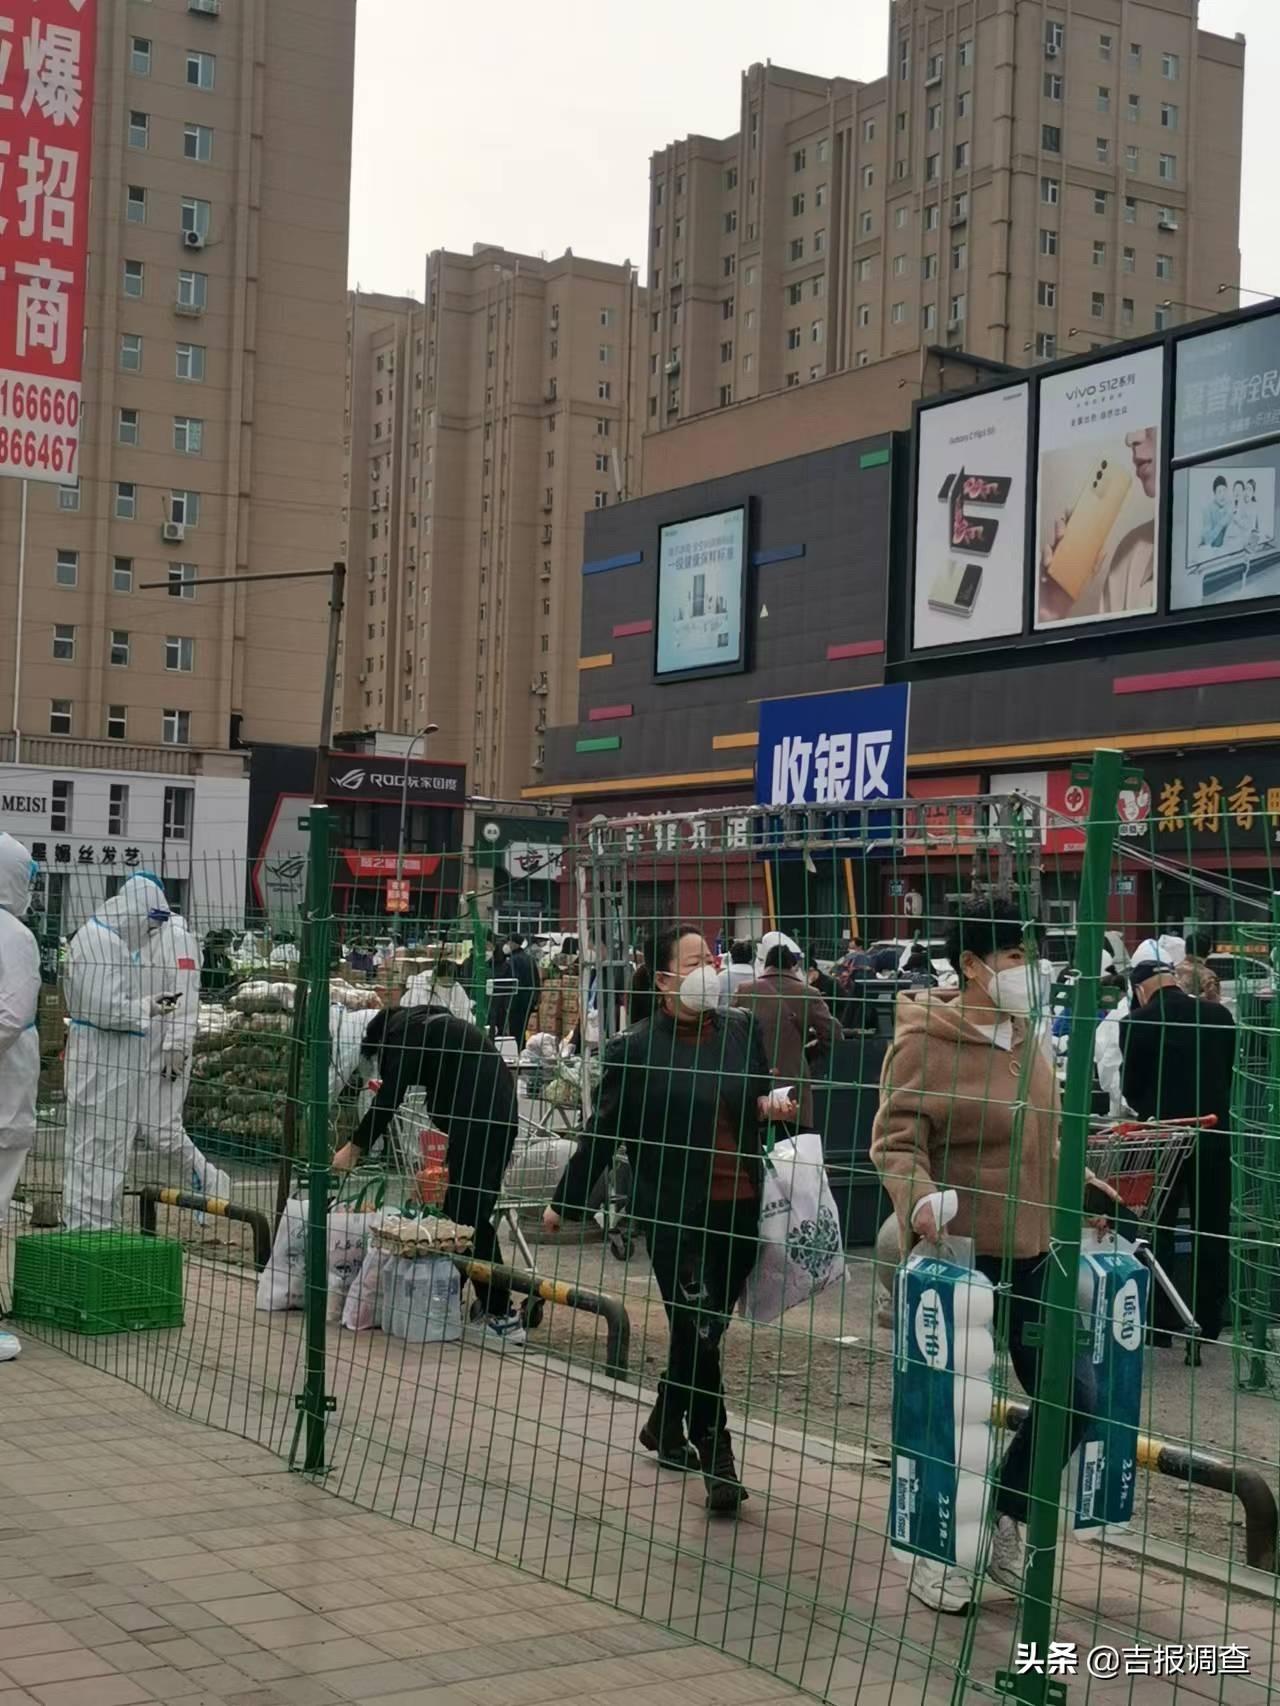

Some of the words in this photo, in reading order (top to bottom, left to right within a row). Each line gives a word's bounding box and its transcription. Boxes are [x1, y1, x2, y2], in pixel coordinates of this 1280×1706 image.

[1065, 385, 1097, 401] vivo
[771, 729, 893, 807] 收银区
[2, 795, 47, 813] MEISI
